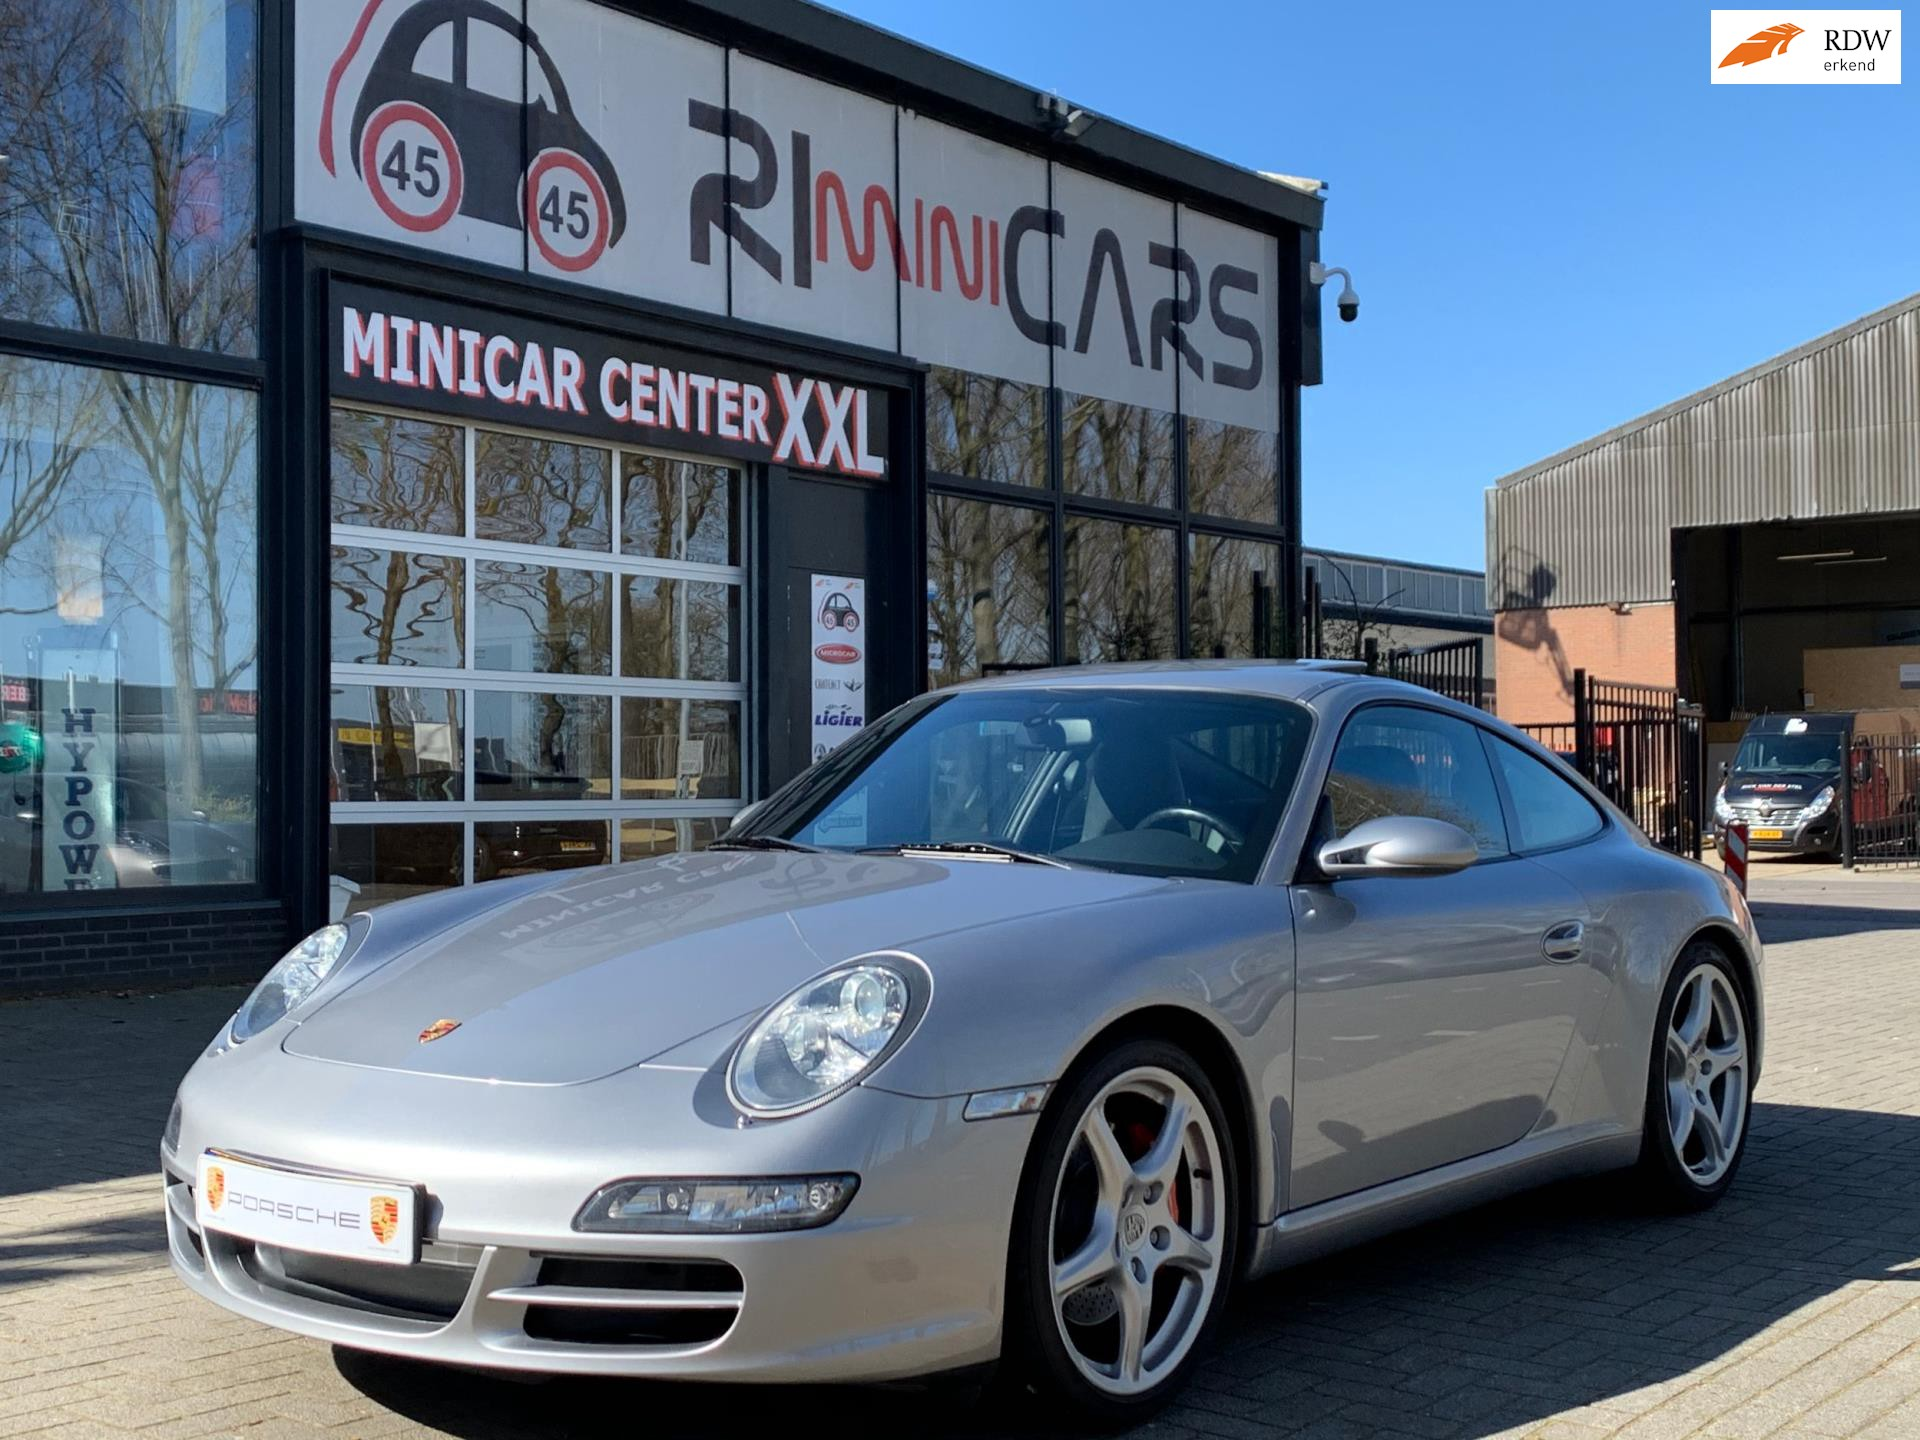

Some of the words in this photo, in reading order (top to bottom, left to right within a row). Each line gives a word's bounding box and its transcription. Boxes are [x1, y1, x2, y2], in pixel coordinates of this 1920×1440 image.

[381, 139, 440, 198] 45
[538, 184, 590, 240] 45
[343, 306, 588, 415] MINICAR
[600, 356, 771, 446] CENTER
[772, 371, 886, 480] XXL
[815, 710, 863, 727] LIGIER
[228, 1190, 361, 1230] PORSCHE
